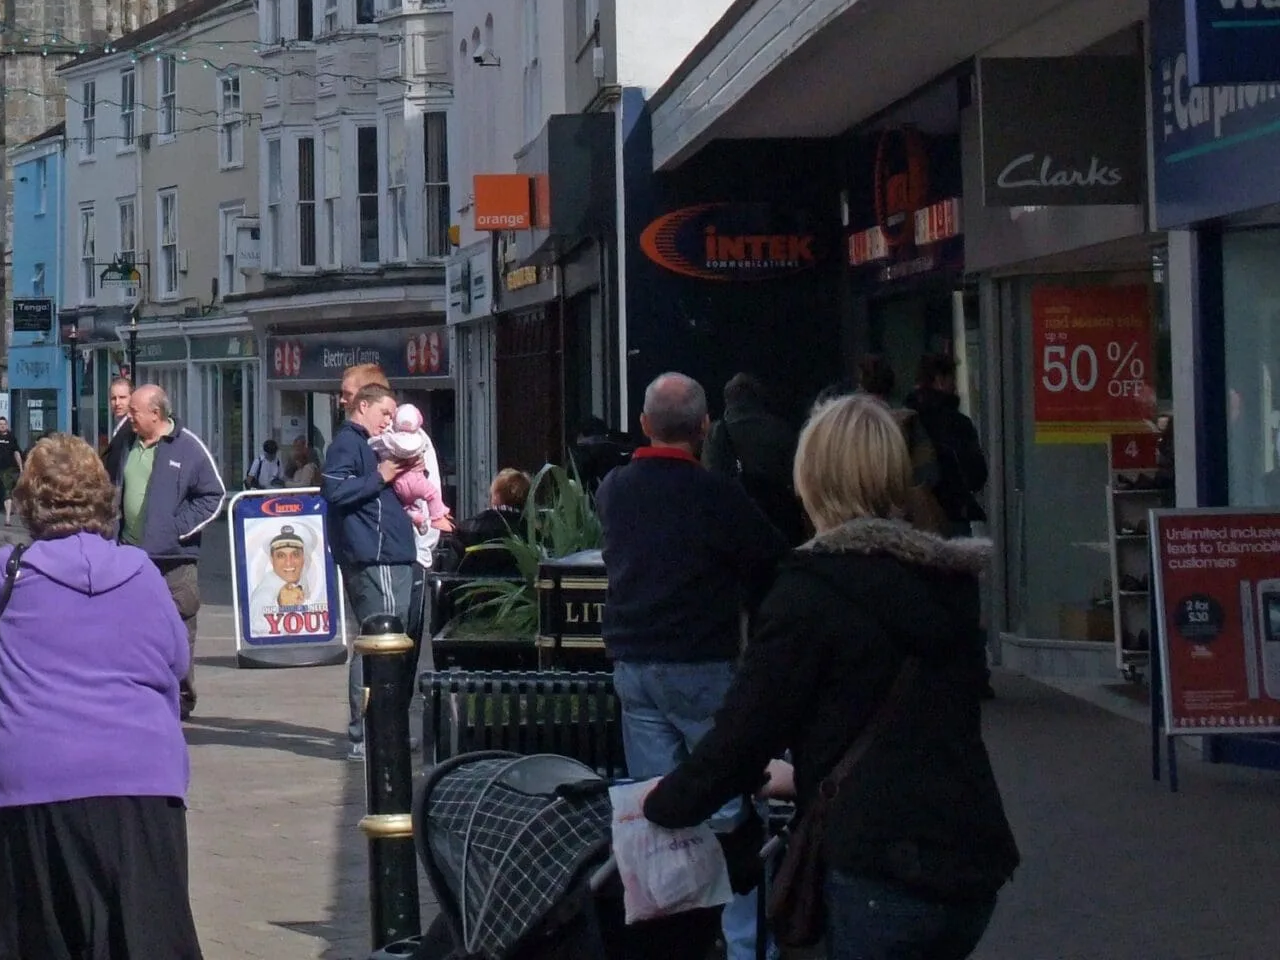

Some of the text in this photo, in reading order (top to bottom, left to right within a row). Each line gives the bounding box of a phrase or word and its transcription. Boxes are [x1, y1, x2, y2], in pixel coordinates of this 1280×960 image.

[997, 152, 1122, 187] Clarks
[478, 214, 525, 227] orange
[323, 348, 355, 368] Electrical
[1042, 344, 1099, 392] 50
[1107, 379, 1145, 397] OFF
[1166, 526, 1280, 540] Unlimited inclusiv
[1167, 541, 1280, 555] texts to Talkmobil
[1168, 558, 1238, 569] customers
[565, 602, 606, 623] LIT
[263, 610, 329, 635] YOU!
